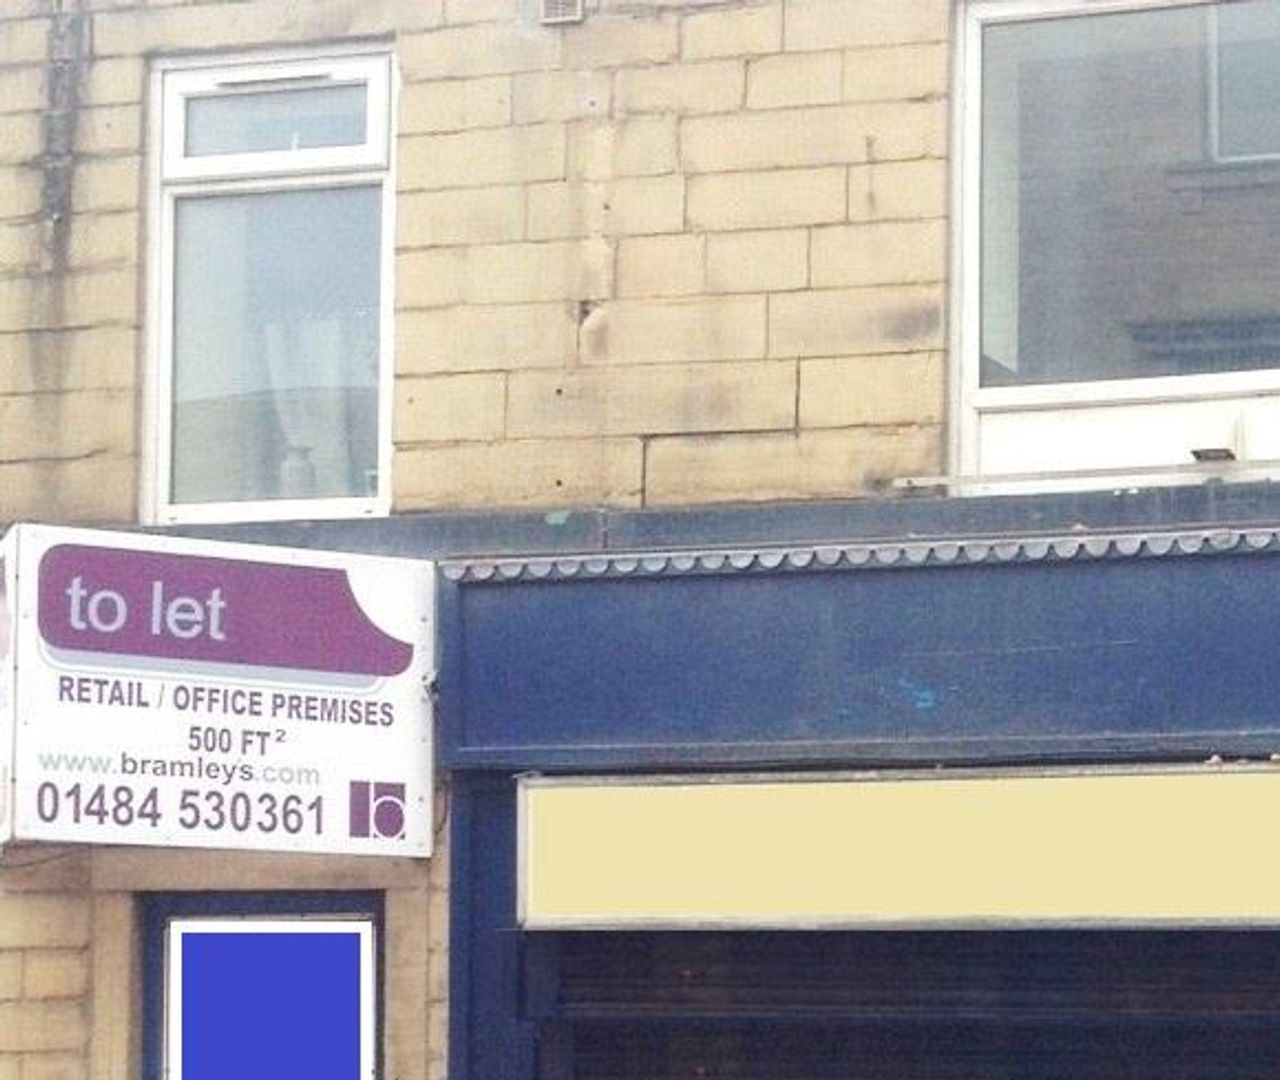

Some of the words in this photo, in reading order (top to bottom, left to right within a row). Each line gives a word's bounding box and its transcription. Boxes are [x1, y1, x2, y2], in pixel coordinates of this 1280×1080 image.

[66, 576, 128, 632] to
[151, 580, 228, 641] let
[58, 675, 150, 708] RETAIL
[173, 684, 263, 717] OFFICE
[271, 692, 395, 727] PREMISES
[188, 726, 232, 754] 500
[38, 751, 320, 786] www.bramleys.com
[37, 781, 162, 828] 01484
[178, 789, 324, 835] 530361
